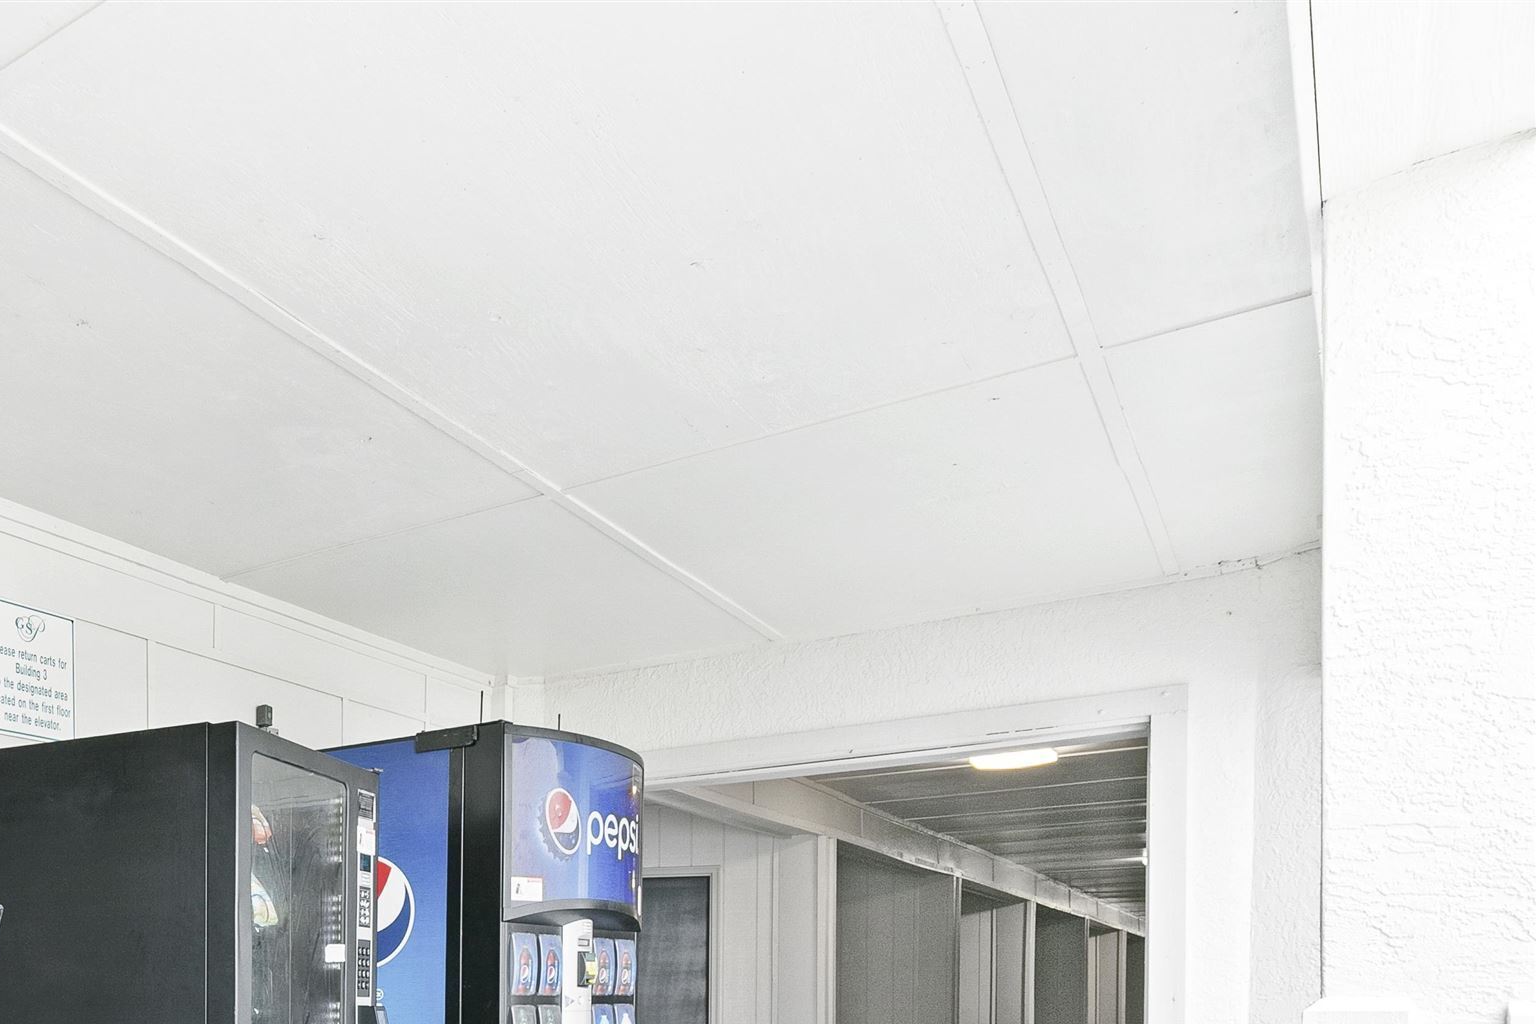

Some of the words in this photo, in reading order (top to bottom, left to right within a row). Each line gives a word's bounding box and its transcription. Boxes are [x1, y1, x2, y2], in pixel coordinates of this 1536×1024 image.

[18, 648, 37, 663] return
[40, 655, 55, 667] carts
[58, 657, 67, 670] for
[15, 663, 41, 681] Building
[43, 669, 48, 681] 3
[3, 677, 14, 689] the
[16, 680, 52, 698] designated
[54, 689, 68, 701] area
[18, 698, 26, 709] on
[29, 698, 39, 711] the
[41, 702, 54, 715] first
[56, 704, 71, 718] floor
[4, 711, 18, 723] near
[21, 712, 32, 726] the
[34, 716, 61, 731] elevator.
[587, 810, 639, 861] pepsi
